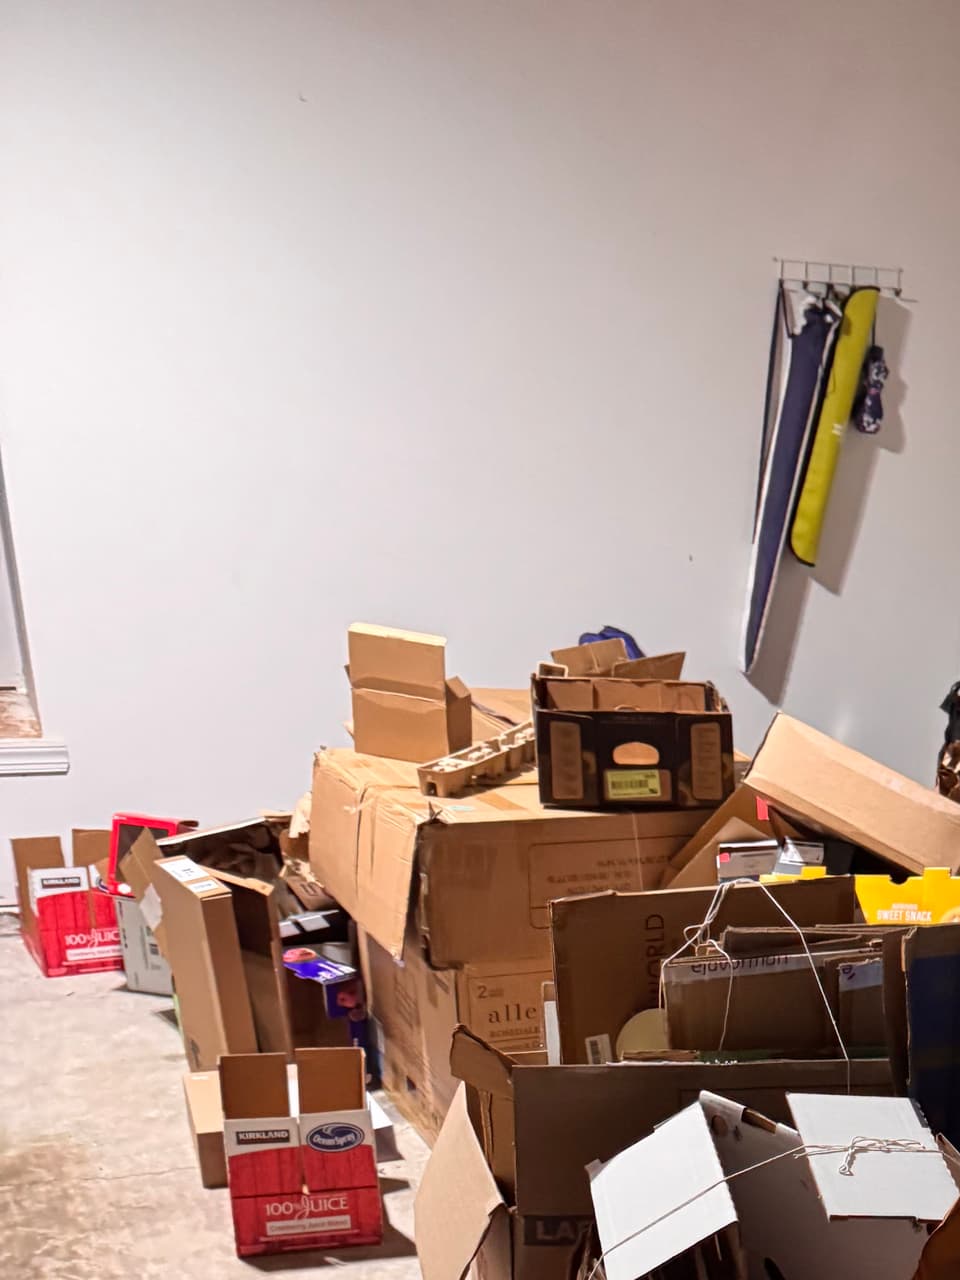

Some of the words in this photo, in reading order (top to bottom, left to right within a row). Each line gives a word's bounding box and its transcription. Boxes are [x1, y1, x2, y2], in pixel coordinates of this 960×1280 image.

[477, 985, 487, 999] 2
[488, 1003, 537, 1023] alle
[238, 1131, 288, 1141] KIRKLAND
[294, 1195, 349, 1220] JUICE
